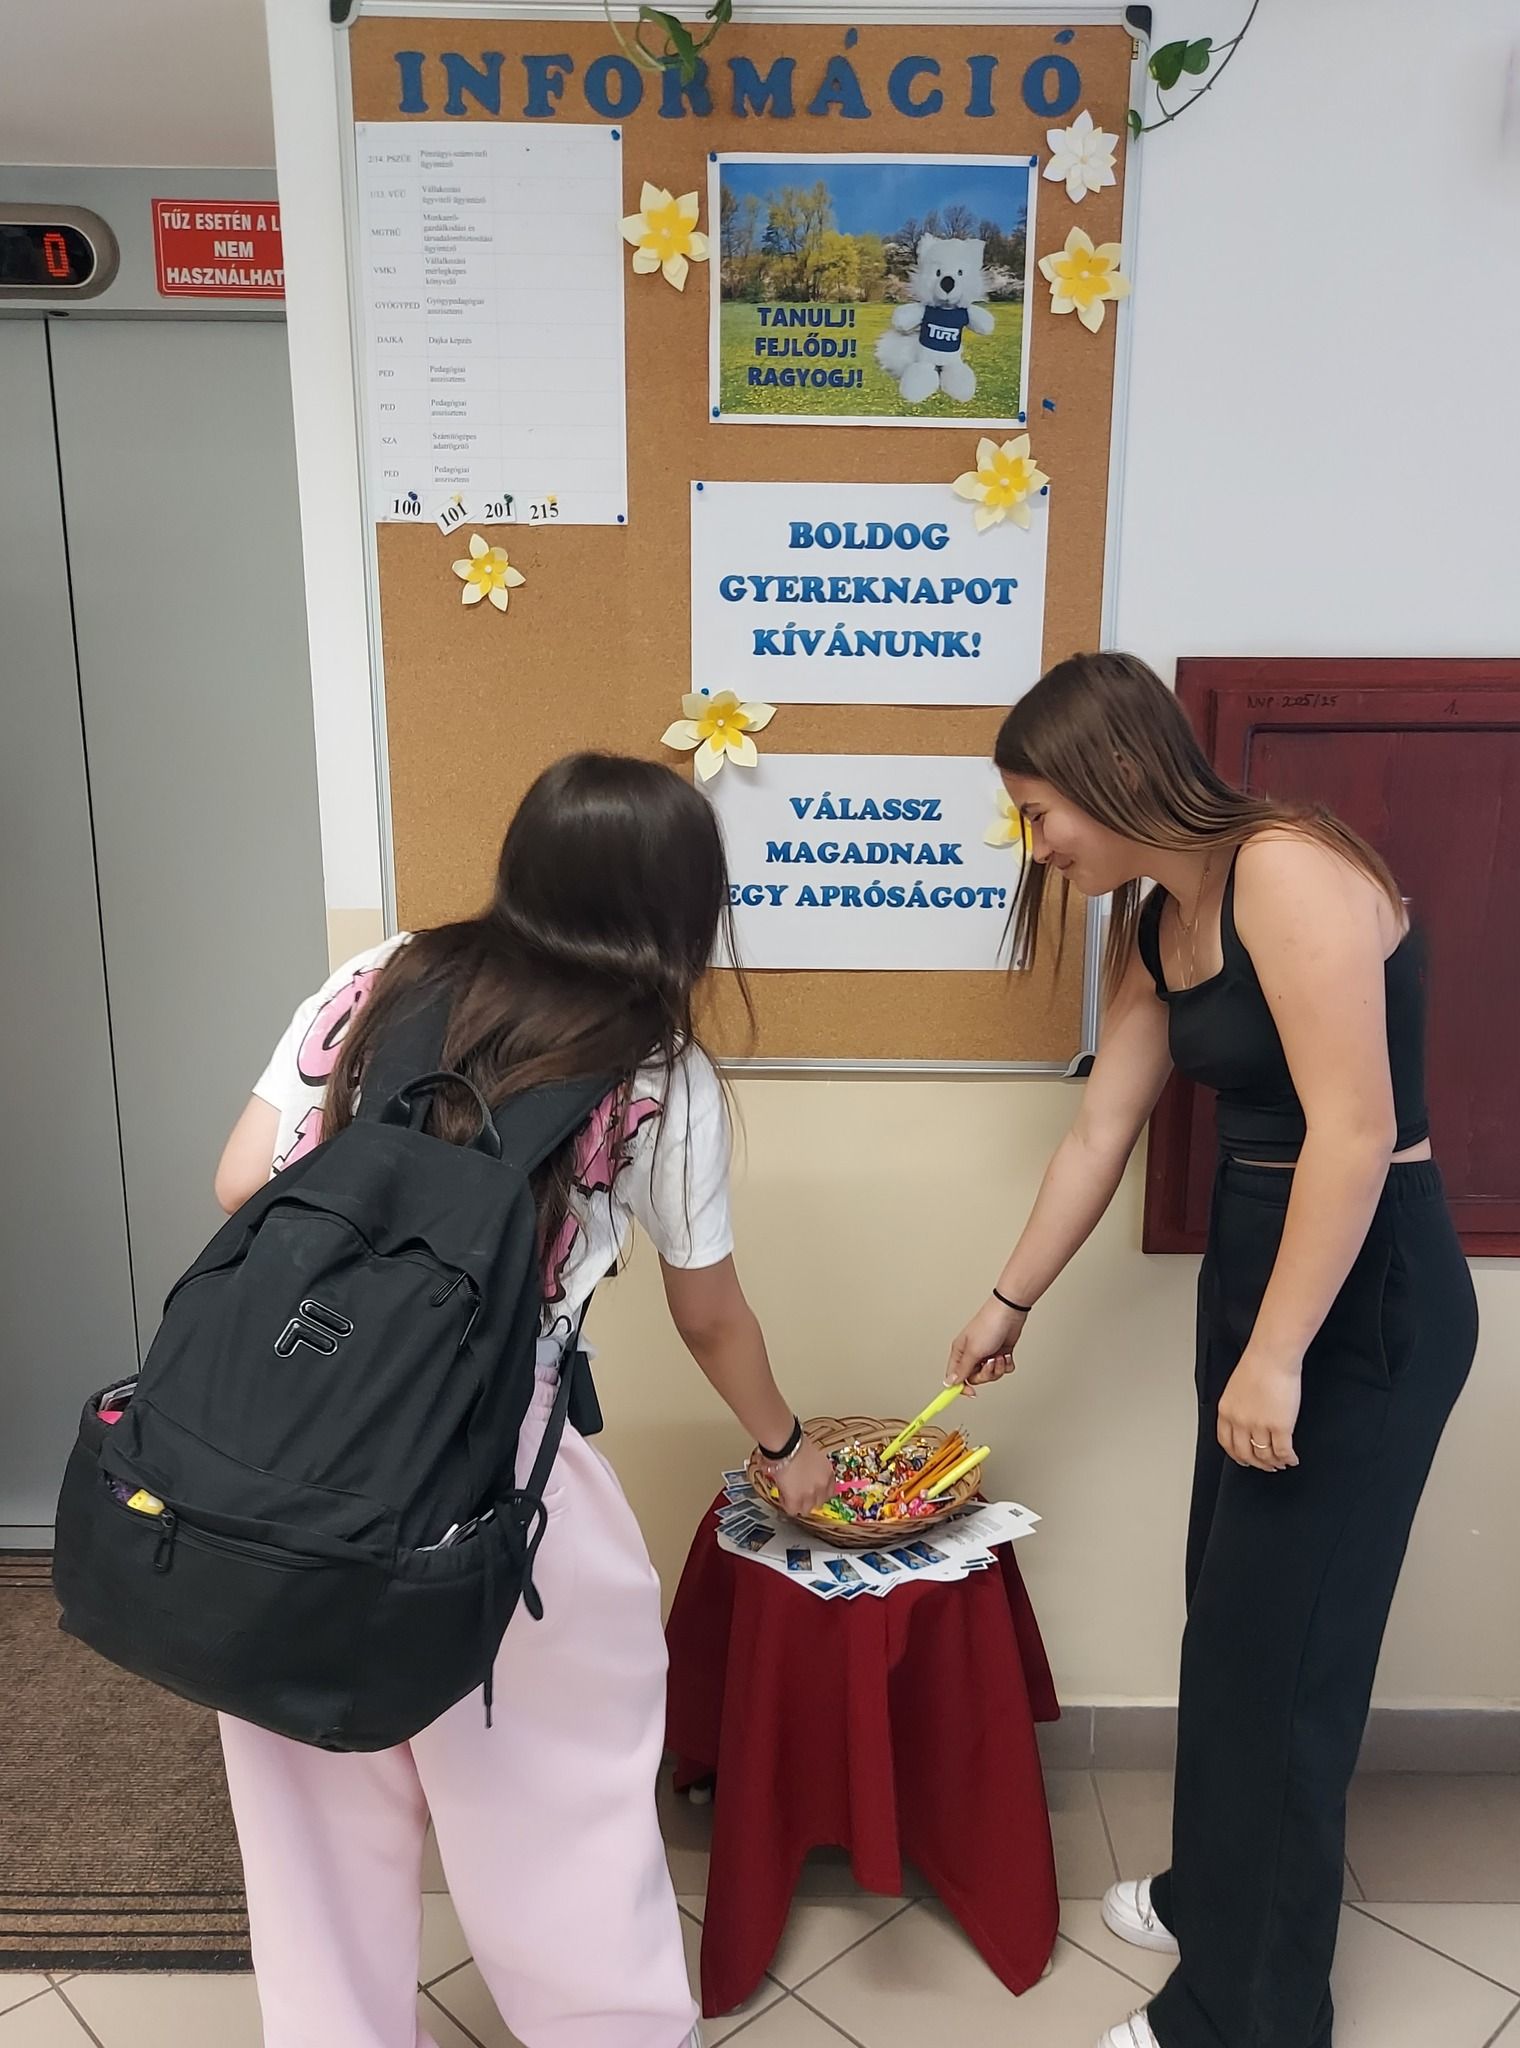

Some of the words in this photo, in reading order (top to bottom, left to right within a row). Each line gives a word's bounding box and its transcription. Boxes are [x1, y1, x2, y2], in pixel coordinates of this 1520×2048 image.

[394, 28, 1082, 119] INFORMÁCIÓ
[162, 208, 191, 230] TŰZ
[196, 210, 251, 231] ESETÉN
[257, 218, 267, 231] A
[44, 233, 70, 277] 0
[214, 241, 254, 258] NEM
[757, 307, 855, 328] TANULJ!
[377, 336, 404, 344] DAJKA
[755, 333, 857, 358] FEJLŐDJ!
[379, 369, 394, 377] PED
[747, 367, 863, 388] RAGYOGJ!
[380, 403, 396, 411] PED
[382, 436, 397, 445] SZA
[384, 470, 399, 478] PED
[392, 499, 421, 516] 100
[440, 501, 468, 527] 101
[484, 502, 512, 519] 201
[529, 503, 559, 520] 215
[788, 522, 949, 550] BOLDOG
[719, 575, 1018, 605] GYEREKNAPOT
[752, 622, 981, 658] KÍVÁNUNK!
[789, 791, 942, 821] VÁLASSZ
[766, 841, 963, 865] MAGADNAK
[728, 884, 788, 906] EGY
[795, 880, 1007, 909] APRÓSÁGOT!
